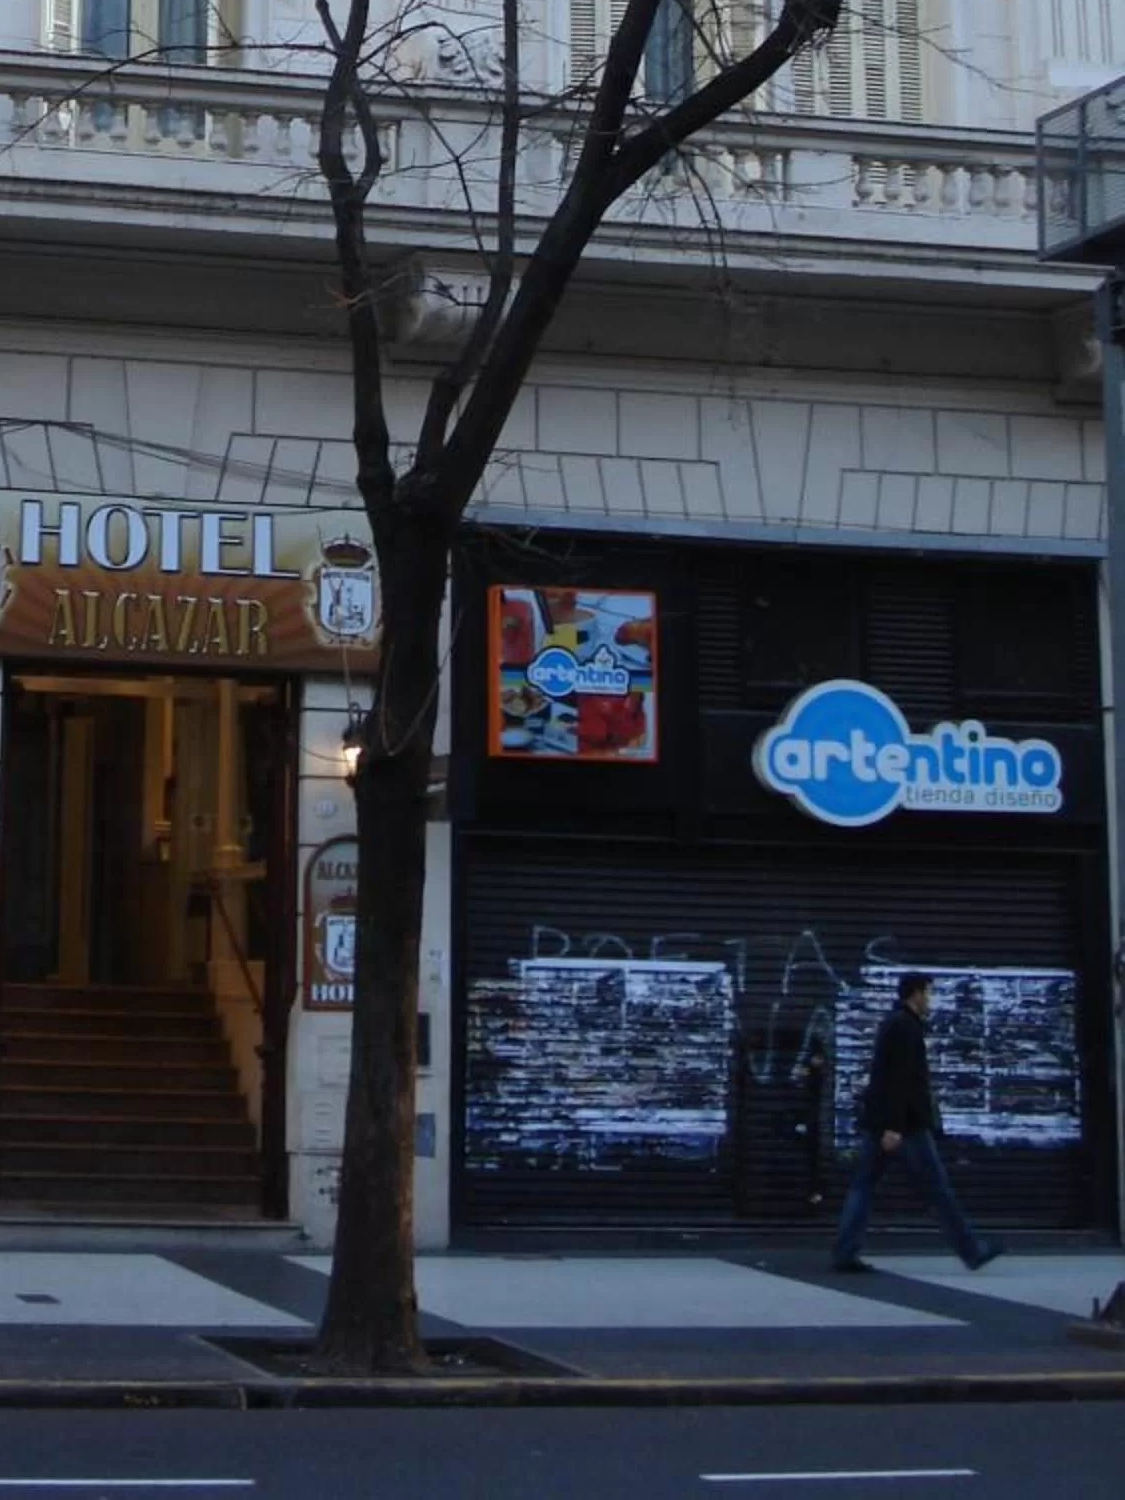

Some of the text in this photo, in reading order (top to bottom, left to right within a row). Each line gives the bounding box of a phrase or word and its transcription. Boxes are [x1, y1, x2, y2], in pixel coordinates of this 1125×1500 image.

[21, 499, 301, 580] HOTEL
[47, 588, 271, 657] ALCAZAR
[774, 728, 1057, 787] artentino
[905, 785, 974, 805] tienda
